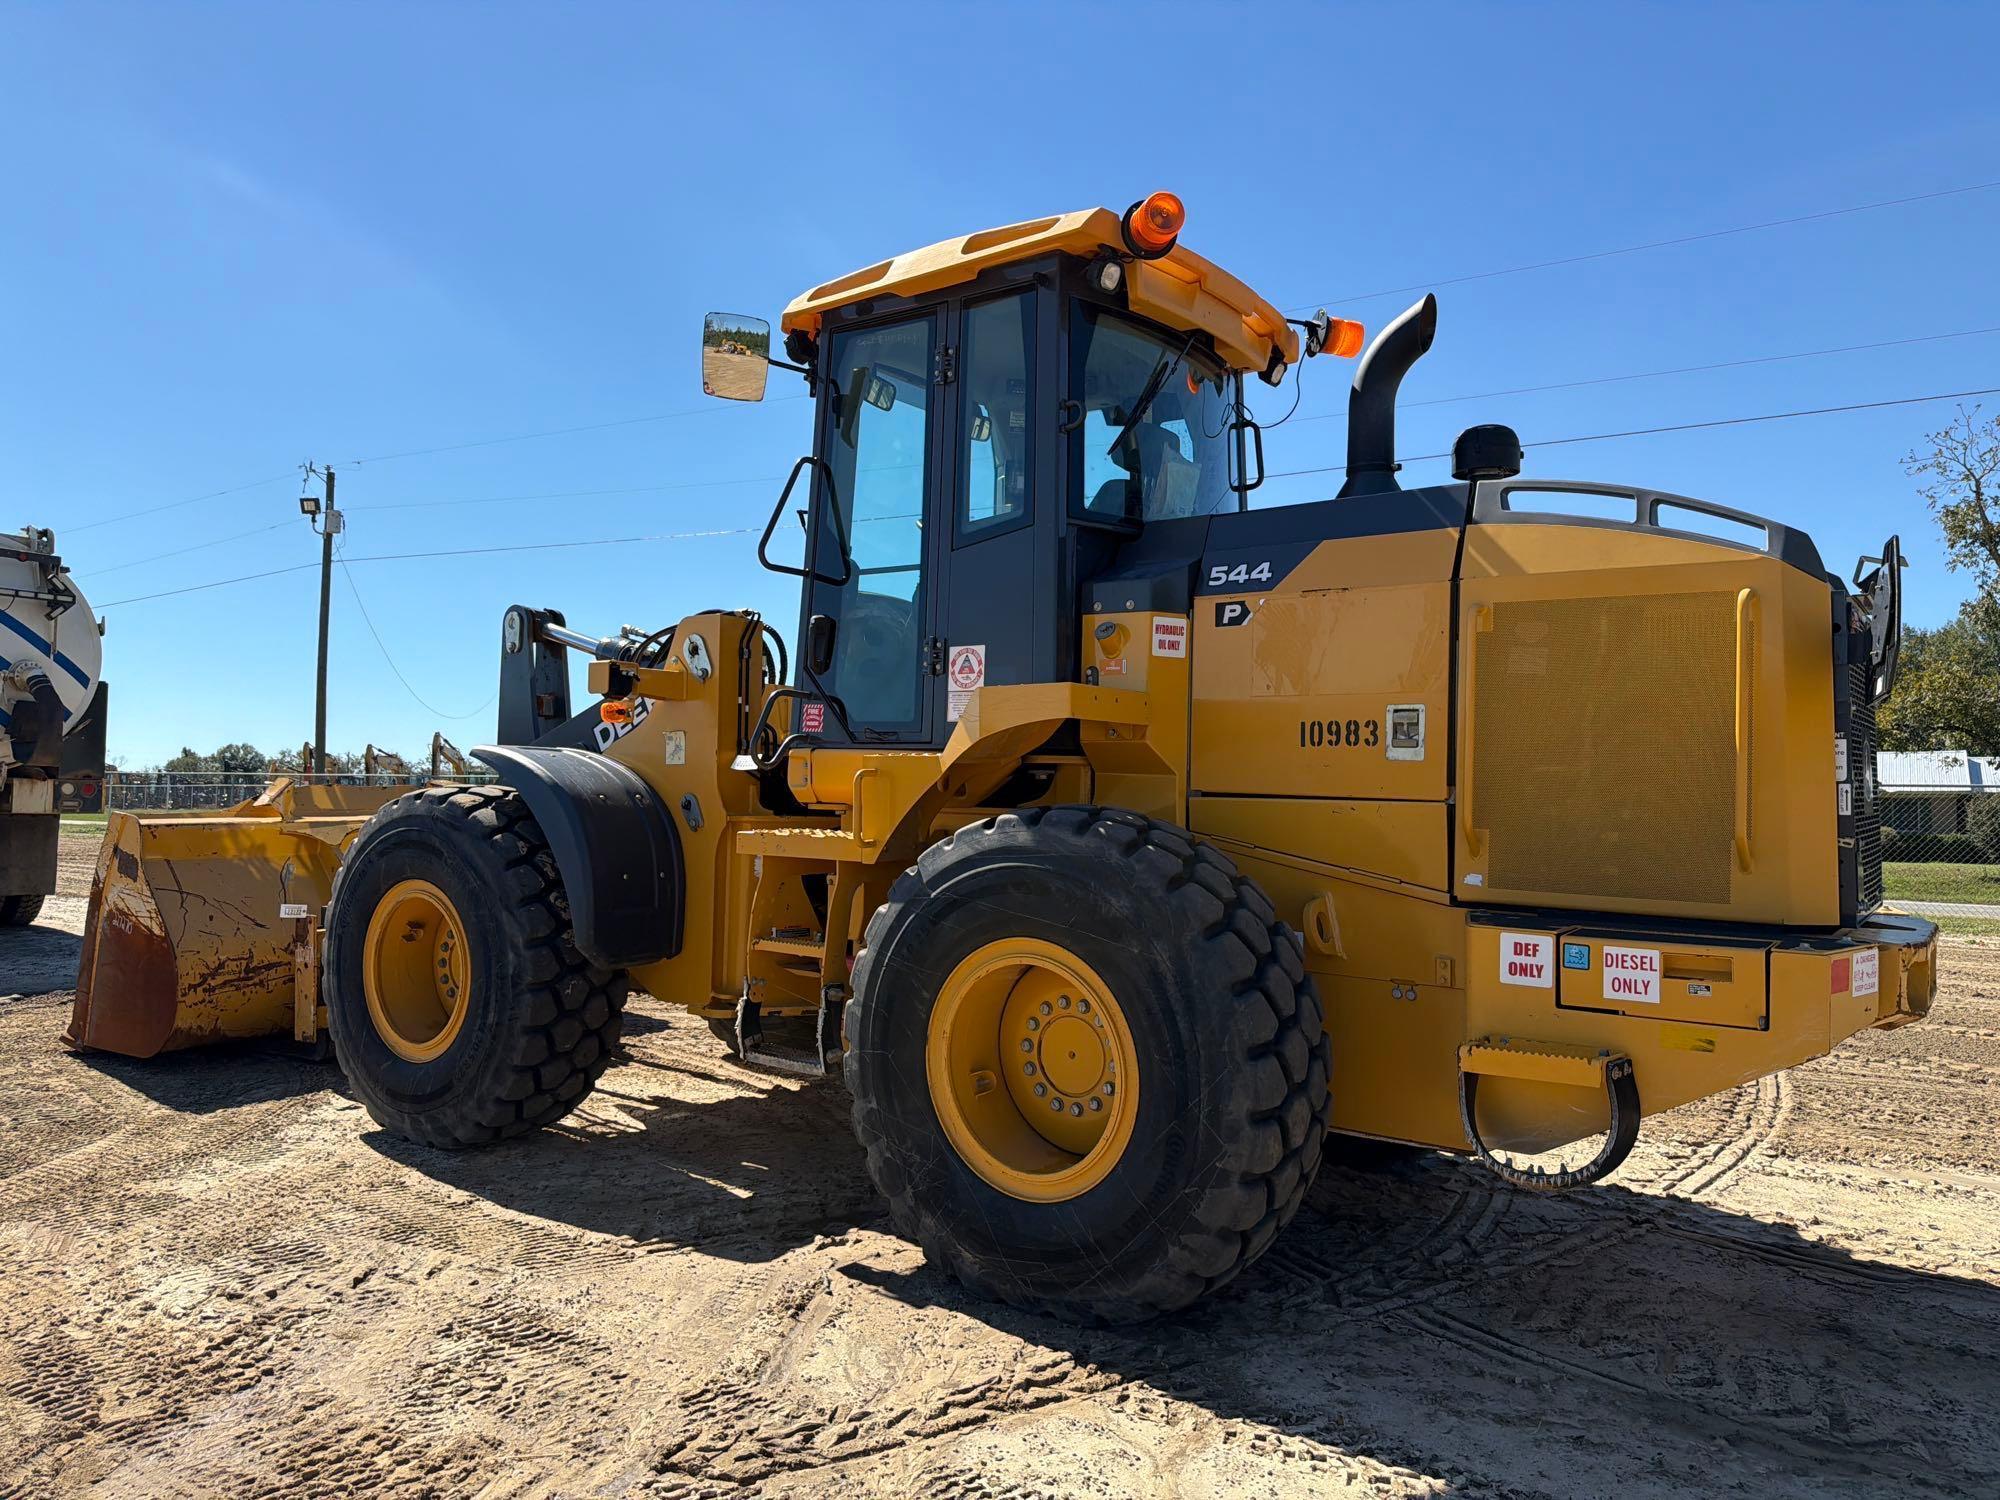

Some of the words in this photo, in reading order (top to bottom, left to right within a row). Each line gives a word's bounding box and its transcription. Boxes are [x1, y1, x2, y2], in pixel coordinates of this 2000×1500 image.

[1208, 562, 1272, 586] 544
[1222, 604, 1242, 624] P
[1154, 624, 1185, 637] HYDRAULIC
[1158, 639, 1167, 650] OIL
[1168, 640, 1181, 651] ONLY
[1300, 719, 1379, 747] 10983
[1513, 941, 1540, 958] DEF
[1508, 961, 1545, 979] ONLY
[1604, 952, 1658, 972] DIESEL
[1611, 977, 1651, 996] ONLY
